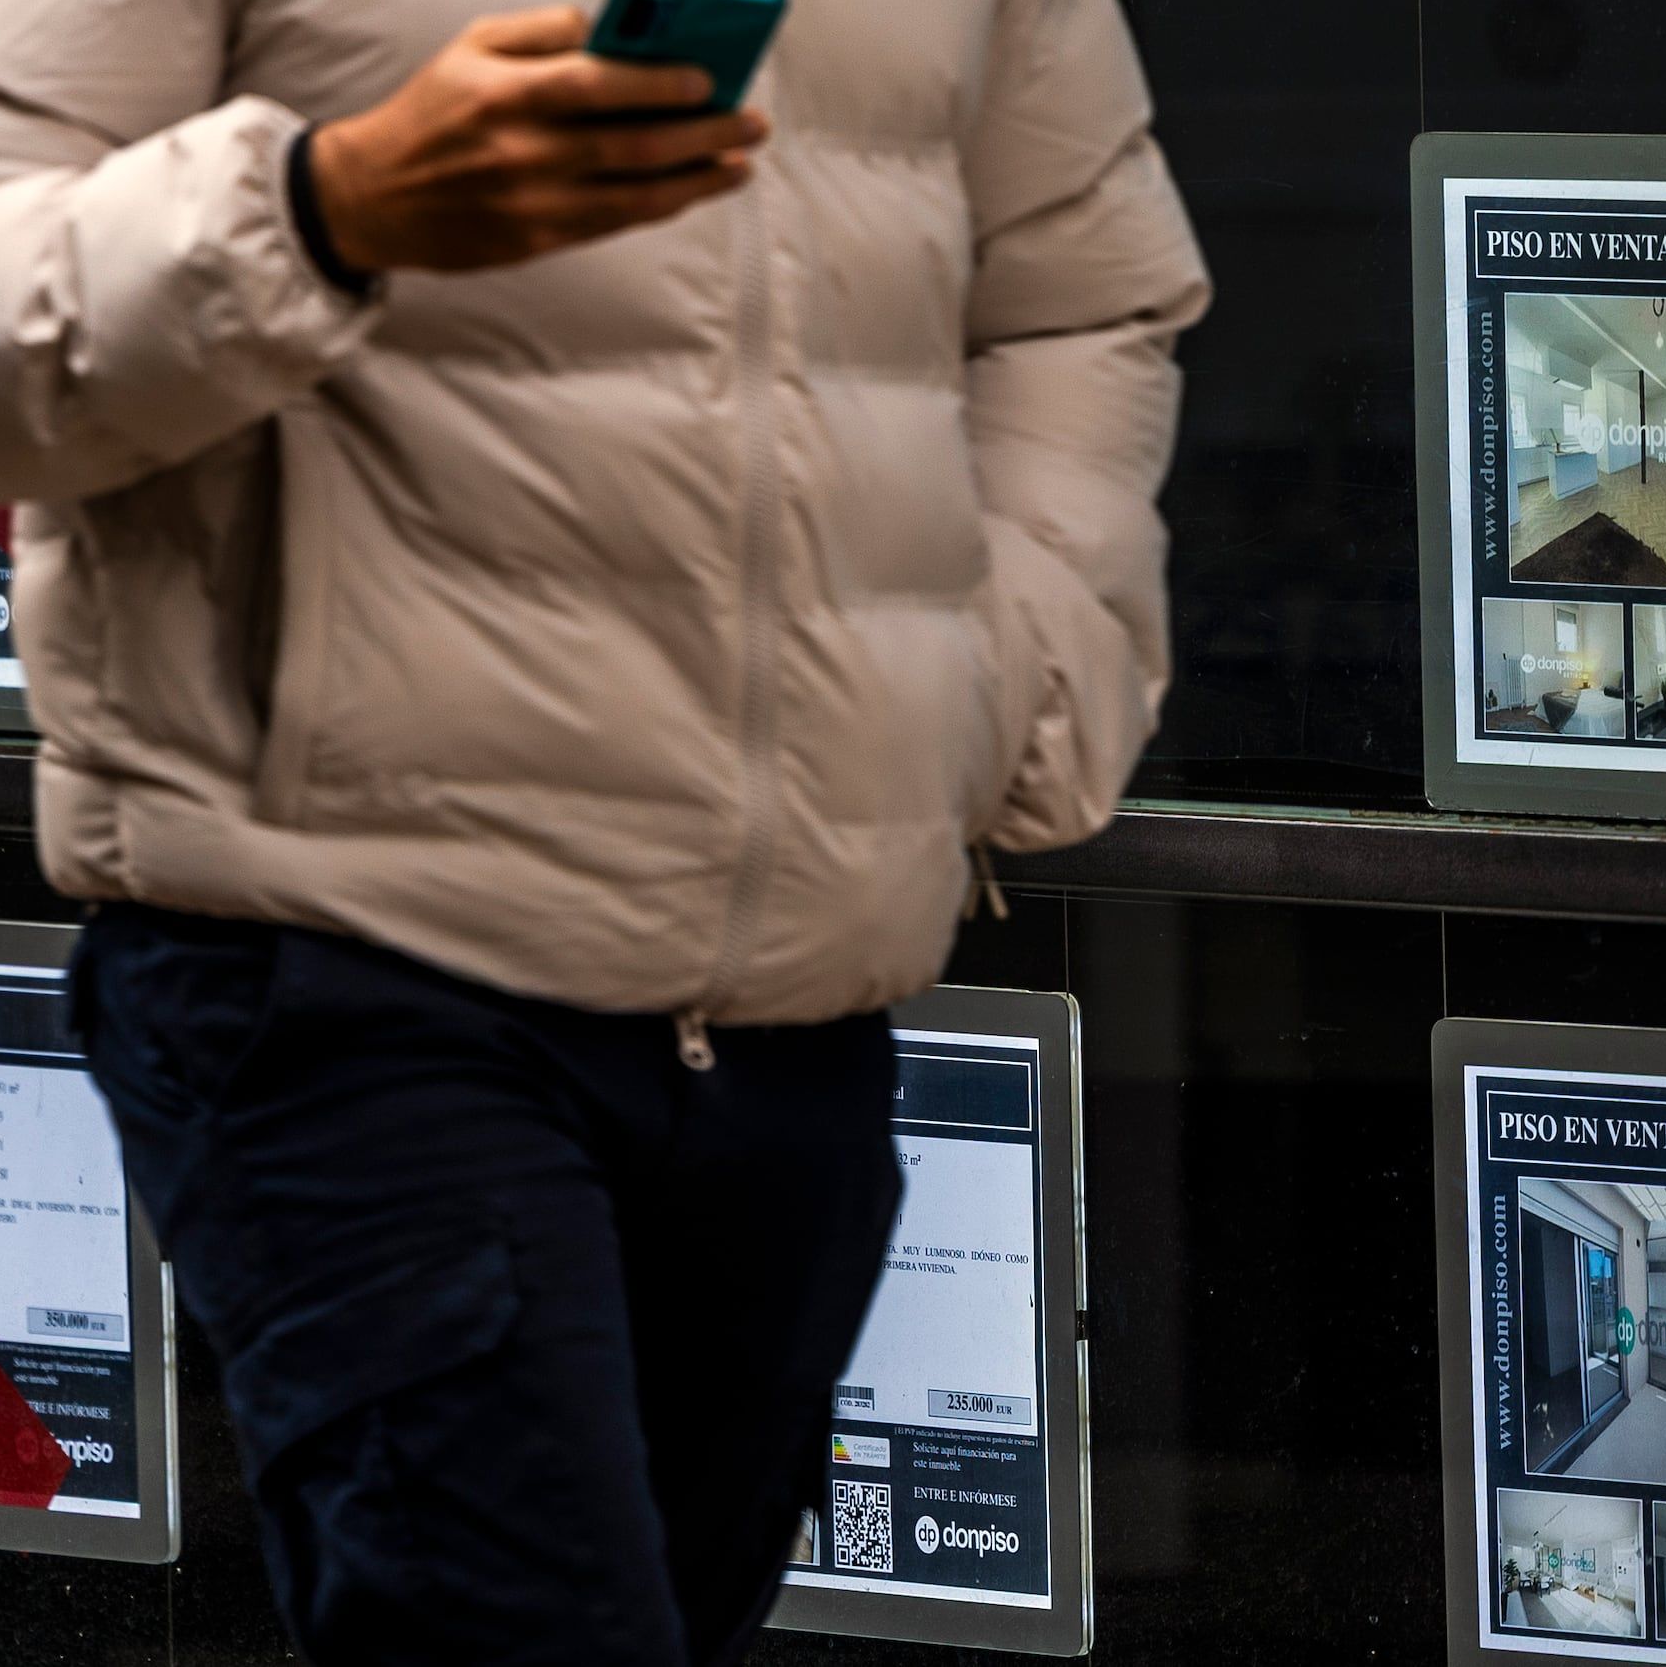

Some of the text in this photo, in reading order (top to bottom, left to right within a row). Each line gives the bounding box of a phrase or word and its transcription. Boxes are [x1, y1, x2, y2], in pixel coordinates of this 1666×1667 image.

[1486, 230, 1543, 259] PISO
[1548, 232, 1583, 259] EN
[1478, 310, 1499, 561] www.donpiso.com
[1498, 1111, 1558, 1142] PISO
[1563, 1116, 1598, 1145] EN
[883, 1260, 957, 1275] PRIMERA VIVIENDA.
[925, 1246, 1029, 1265] LUMINOSO. IDÓNEO COMO
[1491, 1194, 1514, 1451] www.donpiso.com
[947, 1393, 1012, 1415] 235.000 EUR
[912, 1442, 1017, 1463] Solicite aquí financiación para
[942, 1520, 1020, 1558] donpiso
